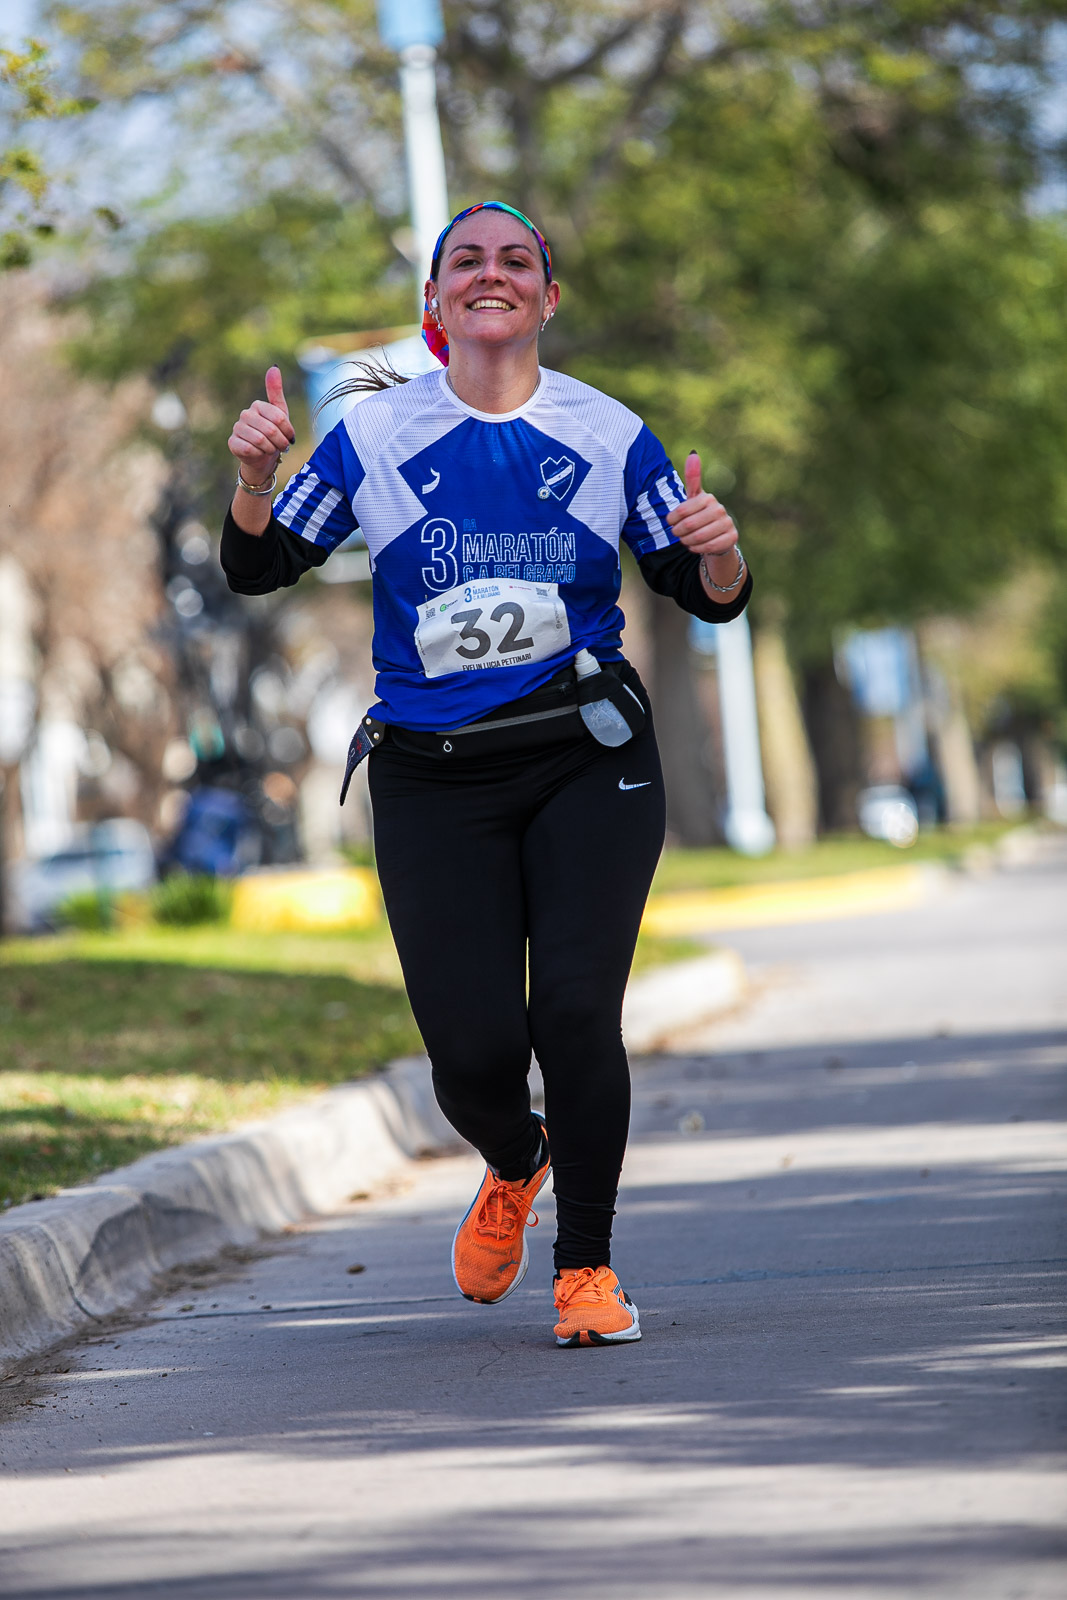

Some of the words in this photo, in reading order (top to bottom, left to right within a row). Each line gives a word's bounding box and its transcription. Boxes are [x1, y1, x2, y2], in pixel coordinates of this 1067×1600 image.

[421, 517, 459, 592] 3
[462, 527, 577, 563] MARATÓN
[464, 587, 473, 603] 3
[472, 585, 499, 595] MARATÓN
[451, 602, 535, 660] 32
[462, 663, 483, 672] EVELIN
[483, 660, 501, 669] LUCIA
[501, 652, 532, 666] PETTINARI
